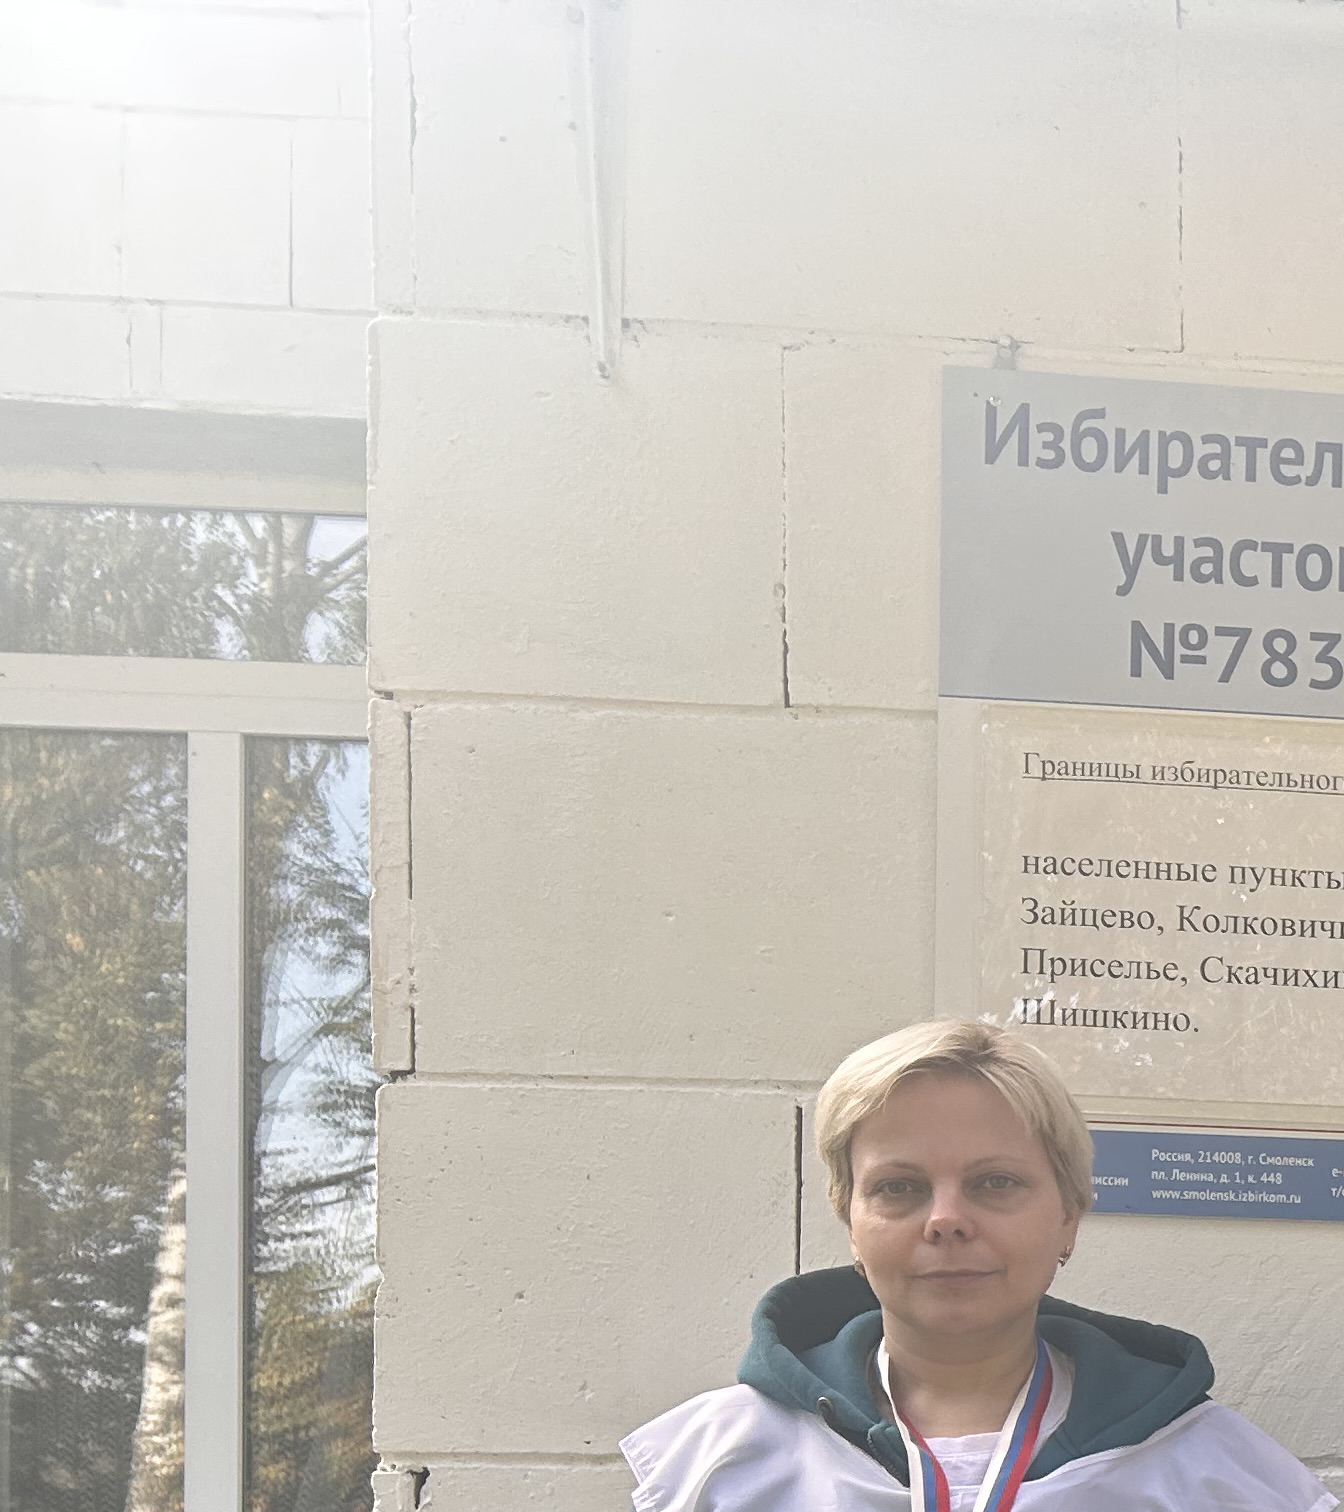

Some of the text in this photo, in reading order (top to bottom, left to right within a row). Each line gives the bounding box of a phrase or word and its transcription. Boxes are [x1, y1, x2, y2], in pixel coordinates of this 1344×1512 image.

[1130, 619, 1344, 690] №783
[1022, 751, 1142, 782] Границы
[1021, 852, 1218, 884] населенные
[1019, 896, 1164, 934] Зайцево,
[1019, 947, 1189, 986] Приселье,
[1020, 998, 1200, 1033] Шишкино.
[1150, 1148, 1194, 1165] Россия,
[1197, 1151, 1245, 1167] 214008,
[1259, 1152, 1315, 1168] Смоленск
[1090, 1176, 1129, 1187] иссии
[1169, 1171, 1216, 1186] Ленина,
[1260, 1172, 1283, 1185] 448
